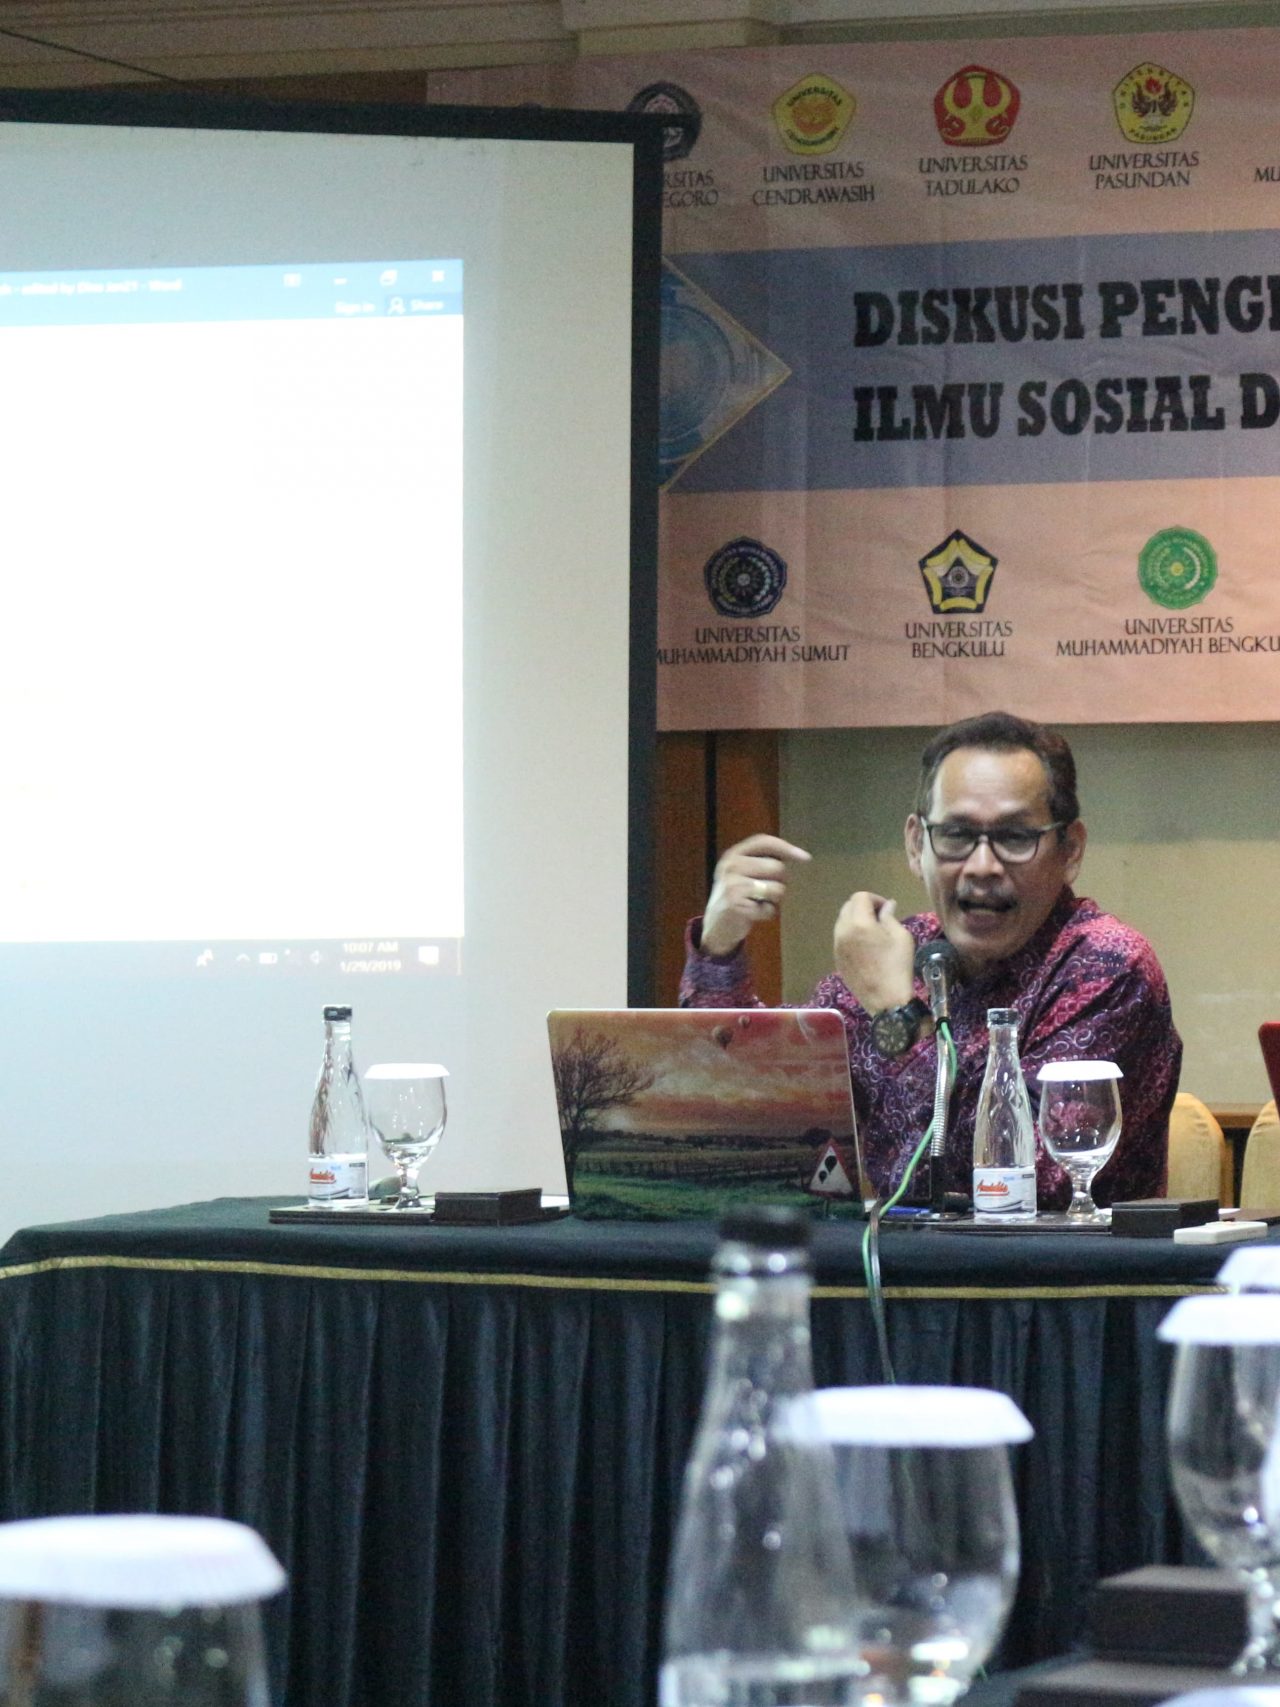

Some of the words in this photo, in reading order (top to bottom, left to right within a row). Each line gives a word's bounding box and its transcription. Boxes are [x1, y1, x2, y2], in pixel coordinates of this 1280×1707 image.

[918, 154, 1029, 173] UNIVERSITAS
[1088, 150, 1200, 172] UNIVERSITAS
[762, 160, 865, 184] UNIVERSITAS
[1093, 170, 1191, 190] PASUNDAN
[752, 185, 875, 207] CENDRAWASIH
[925, 176, 1020, 197] TADULAKO
[852, 283, 1085, 347] DISKUSI
[852, 381, 1005, 441] ILMU
[1017, 373, 1226, 437] SOSIAL
[695, 625, 801, 644] UNIVERSITAS
[905, 620, 1014, 639] UNIVERSITAS
[1125, 616, 1235, 636] UNIVERSITAS
[791, 644, 851, 663] SUMUT
[911, 639, 1006, 659] BENGKULU
[1056, 637, 1204, 657] MUHAMMADIYAH
